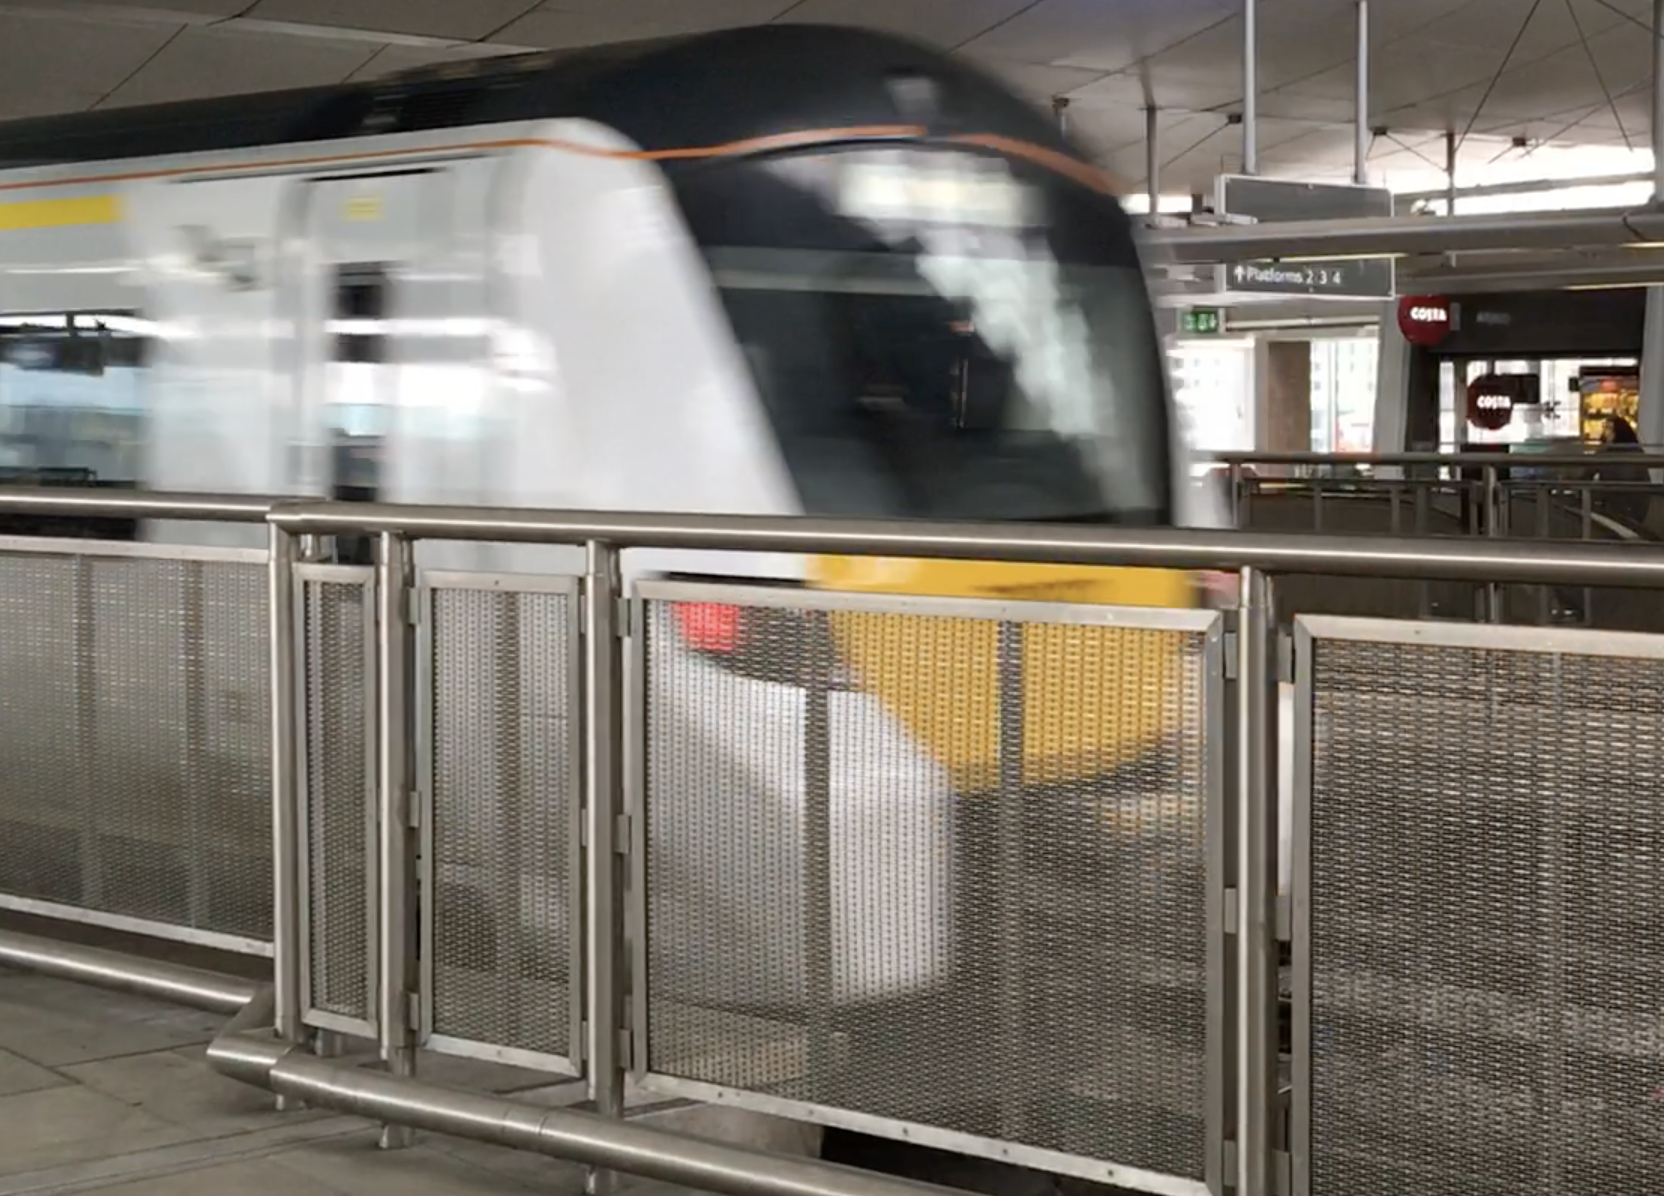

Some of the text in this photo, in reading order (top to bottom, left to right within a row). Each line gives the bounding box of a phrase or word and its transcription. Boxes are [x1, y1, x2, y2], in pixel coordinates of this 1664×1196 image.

[1246, 266, 1341, 285] Platforms 2 3 4
[1410, 307, 1447, 322] COSTA
[1477, 395, 1511, 410] COSTA
